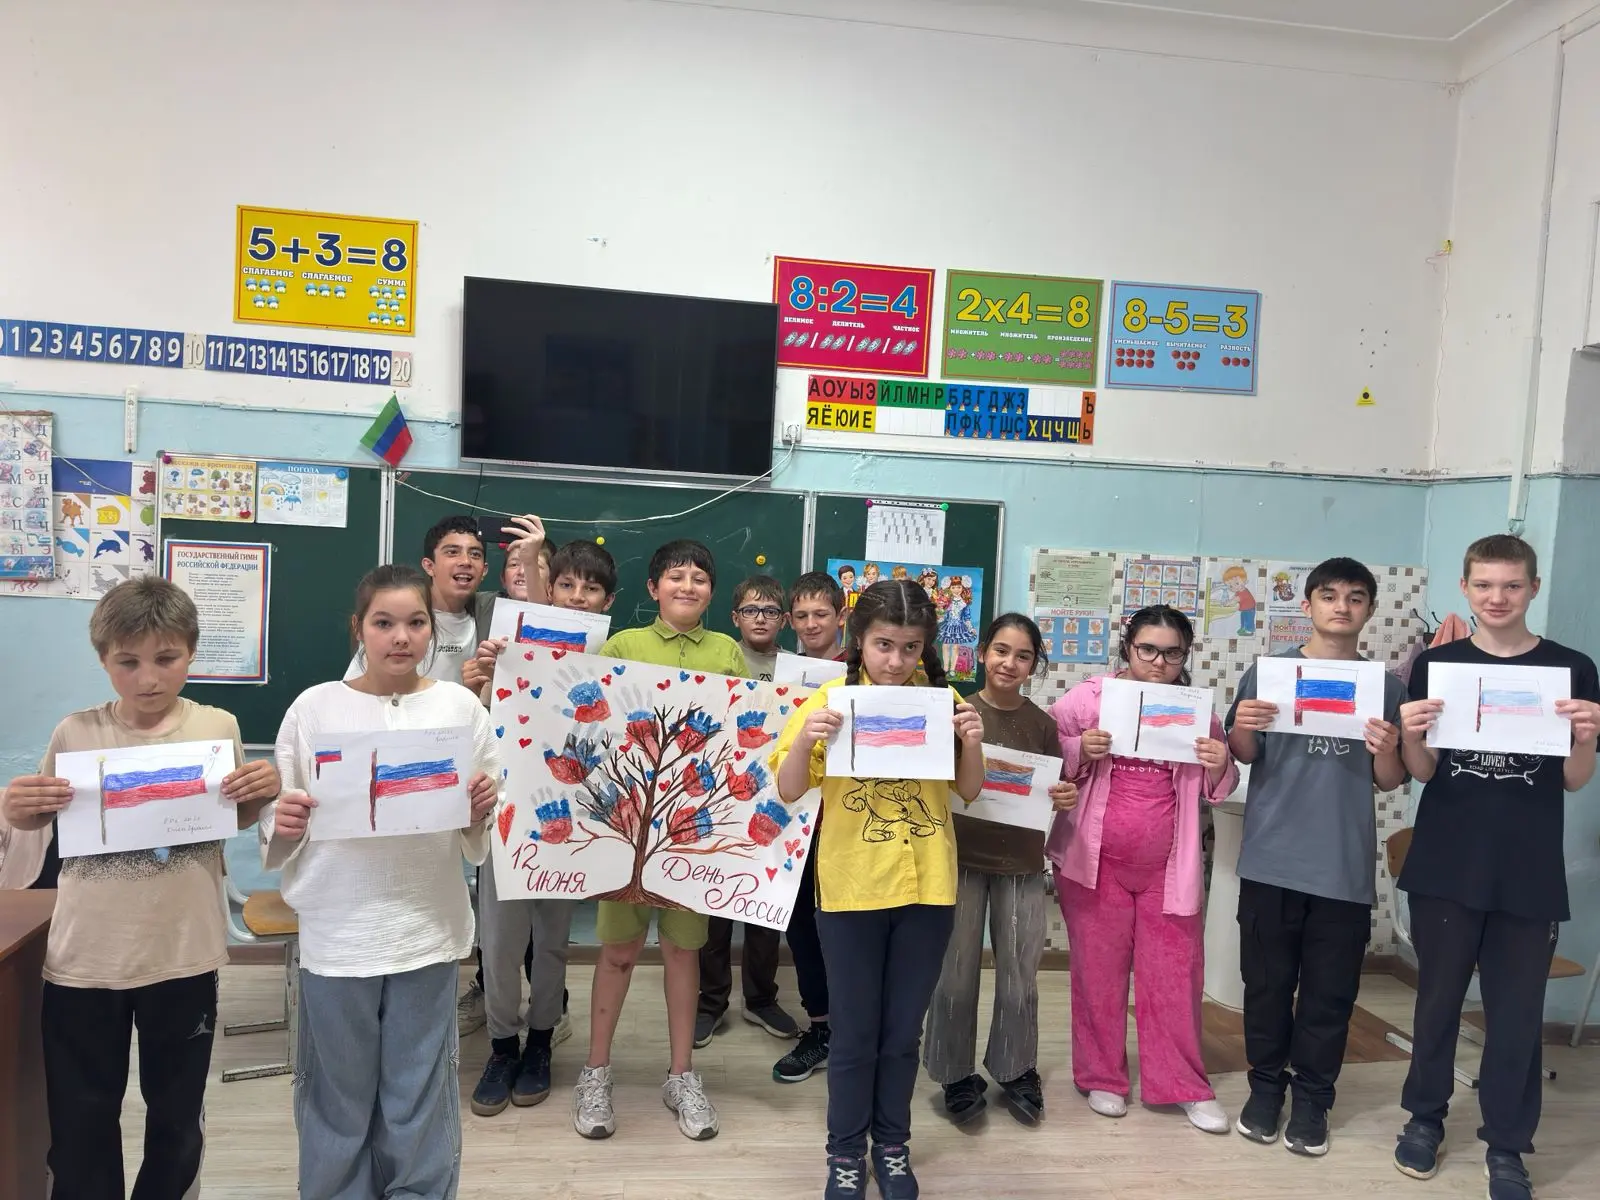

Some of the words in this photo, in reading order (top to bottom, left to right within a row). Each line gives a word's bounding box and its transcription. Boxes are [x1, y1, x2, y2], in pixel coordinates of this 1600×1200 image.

[248, 226, 408, 272] 5+3=8
[377, 278, 407, 287] СУММА
[789, 275, 919, 319] 8:2=4
[1123, 298, 1248, 339] 8-5=3
[950, 328, 989, 337] МНОЖИТЕЛЬ
[1000, 331, 1038, 340] МНОЖИТЕЛЬ
[12, 326, 20, 351] 1
[29, 328, 43, 353] 2
[50, 329, 63, 354] 3
[70, 331, 84, 355] 4
[89, 332, 103, 357] 5
[109, 334, 122, 359] 6
[129, 335, 142, 360] 7
[149, 336, 162, 361] 8
[168, 337, 181, 362] 9
[208, 341, 224, 366] 11
[228, 343, 245, 368] 12
[249, 345, 267, 370] 13
[269, 346, 287, 371] 14
[290, 348, 307, 373] 15
[311, 350, 328, 375] 16
[331, 352, 349, 377] 17
[352, 353, 370, 378] 18
[372, 355, 390, 380] 19
[287, 465, 320, 474] ПОГОДА
[177, 551, 240, 560] ГОСУДАРСТВЕННЫЙ
[240, 553, 258, 561] ГИМН
[177, 560, 220, 569] РОССИЙСКОЙ
[220, 562, 259, 571] ФЕДЕРАЦИИ
[1480, 754, 1506, 768] LOVER
[512, 843, 540, 870] 12
[661, 856, 725, 884] День
[705, 873, 790, 925] России
